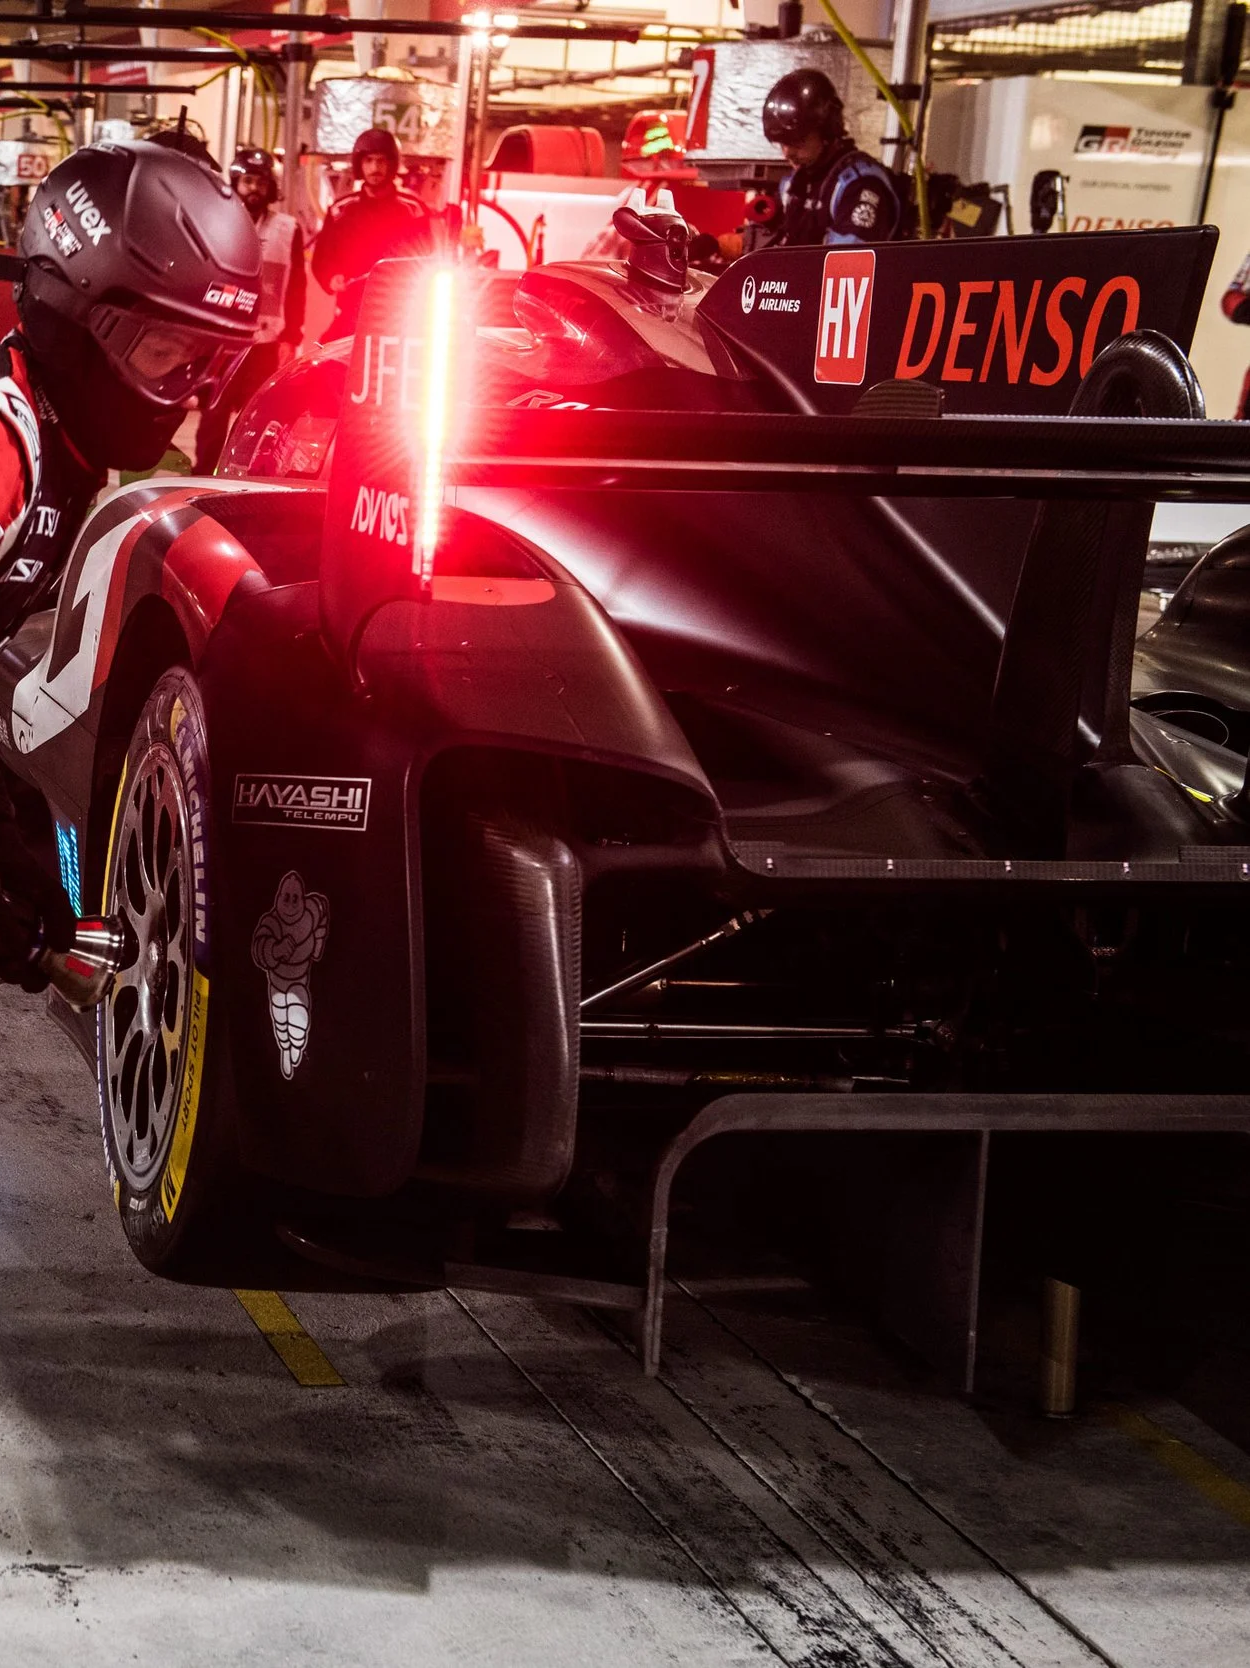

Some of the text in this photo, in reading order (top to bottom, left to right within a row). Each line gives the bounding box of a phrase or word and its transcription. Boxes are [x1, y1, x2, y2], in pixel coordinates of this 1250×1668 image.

[374, 103, 421, 141] 54
[20, 156, 47, 176] 50
[65, 180, 112, 246] uvex
[758, 280, 788, 295] JAPAN
[758, 298, 801, 312] AIRLINES
[820, 277, 869, 359] HY
[895, 276, 1140, 386] DENSO
[239, 783, 363, 809] HAYASHI
[283, 810, 359, 823] TELEMPU
[181, 752, 208, 945] MICHELIN
[181, 989, 201, 1134] PILOT SPORT
